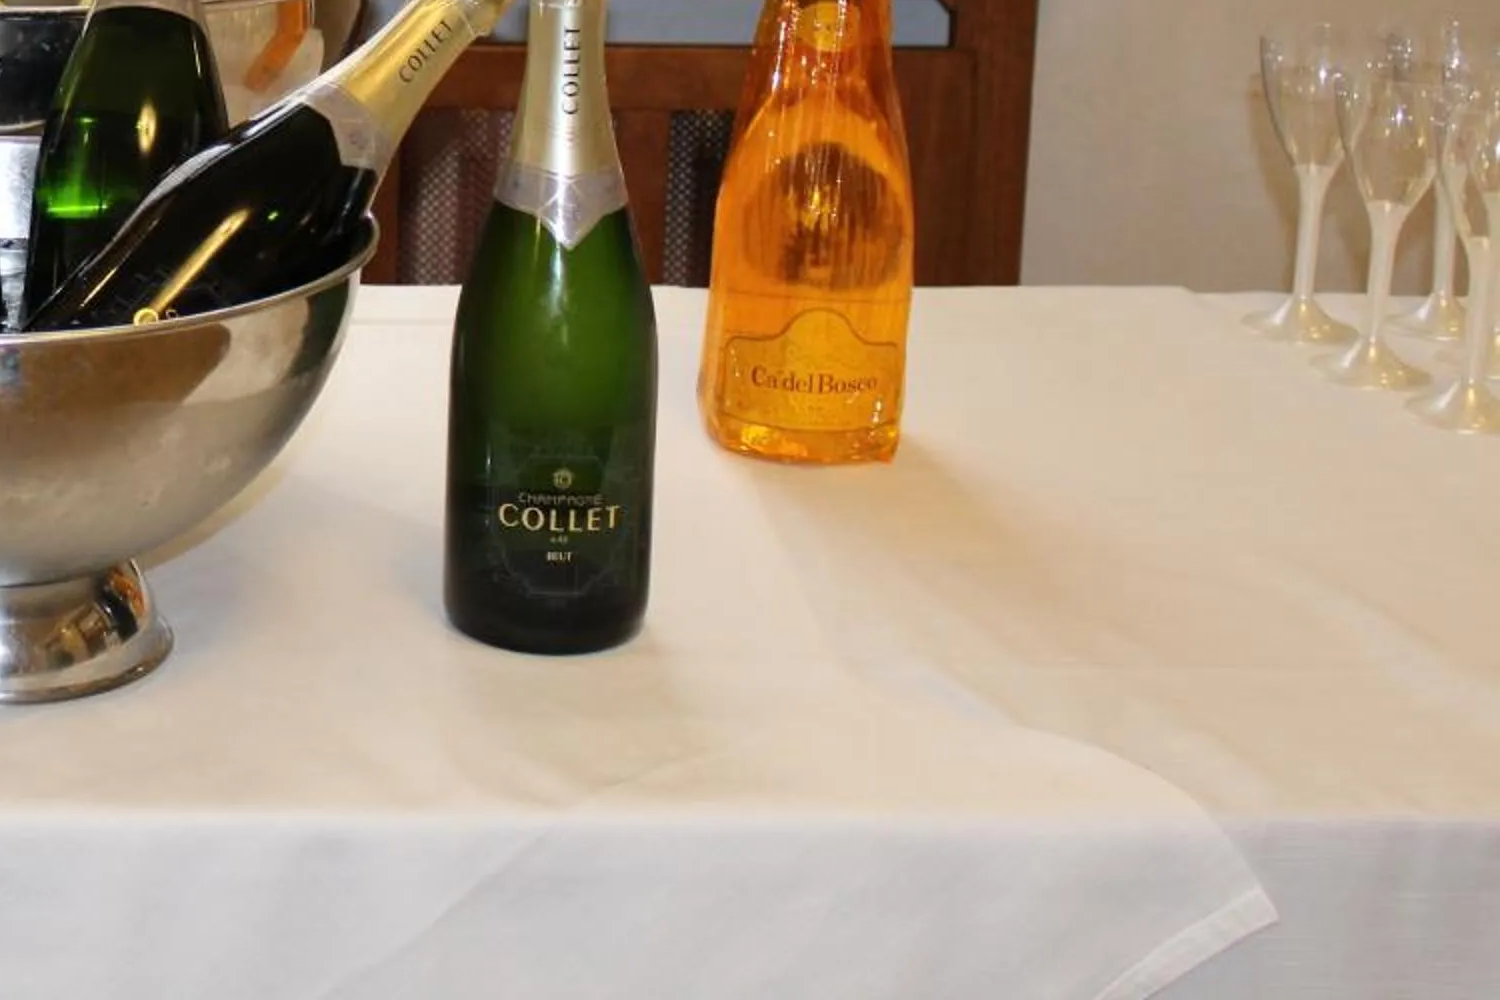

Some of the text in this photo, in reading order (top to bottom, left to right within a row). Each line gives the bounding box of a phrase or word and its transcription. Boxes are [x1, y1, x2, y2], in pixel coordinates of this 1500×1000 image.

[398, 20, 453, 83] COLLET
[562, 28, 581, 115] COLLET
[818, 372, 878, 394] Bosco
[498, 503, 620, 532] COLLET
